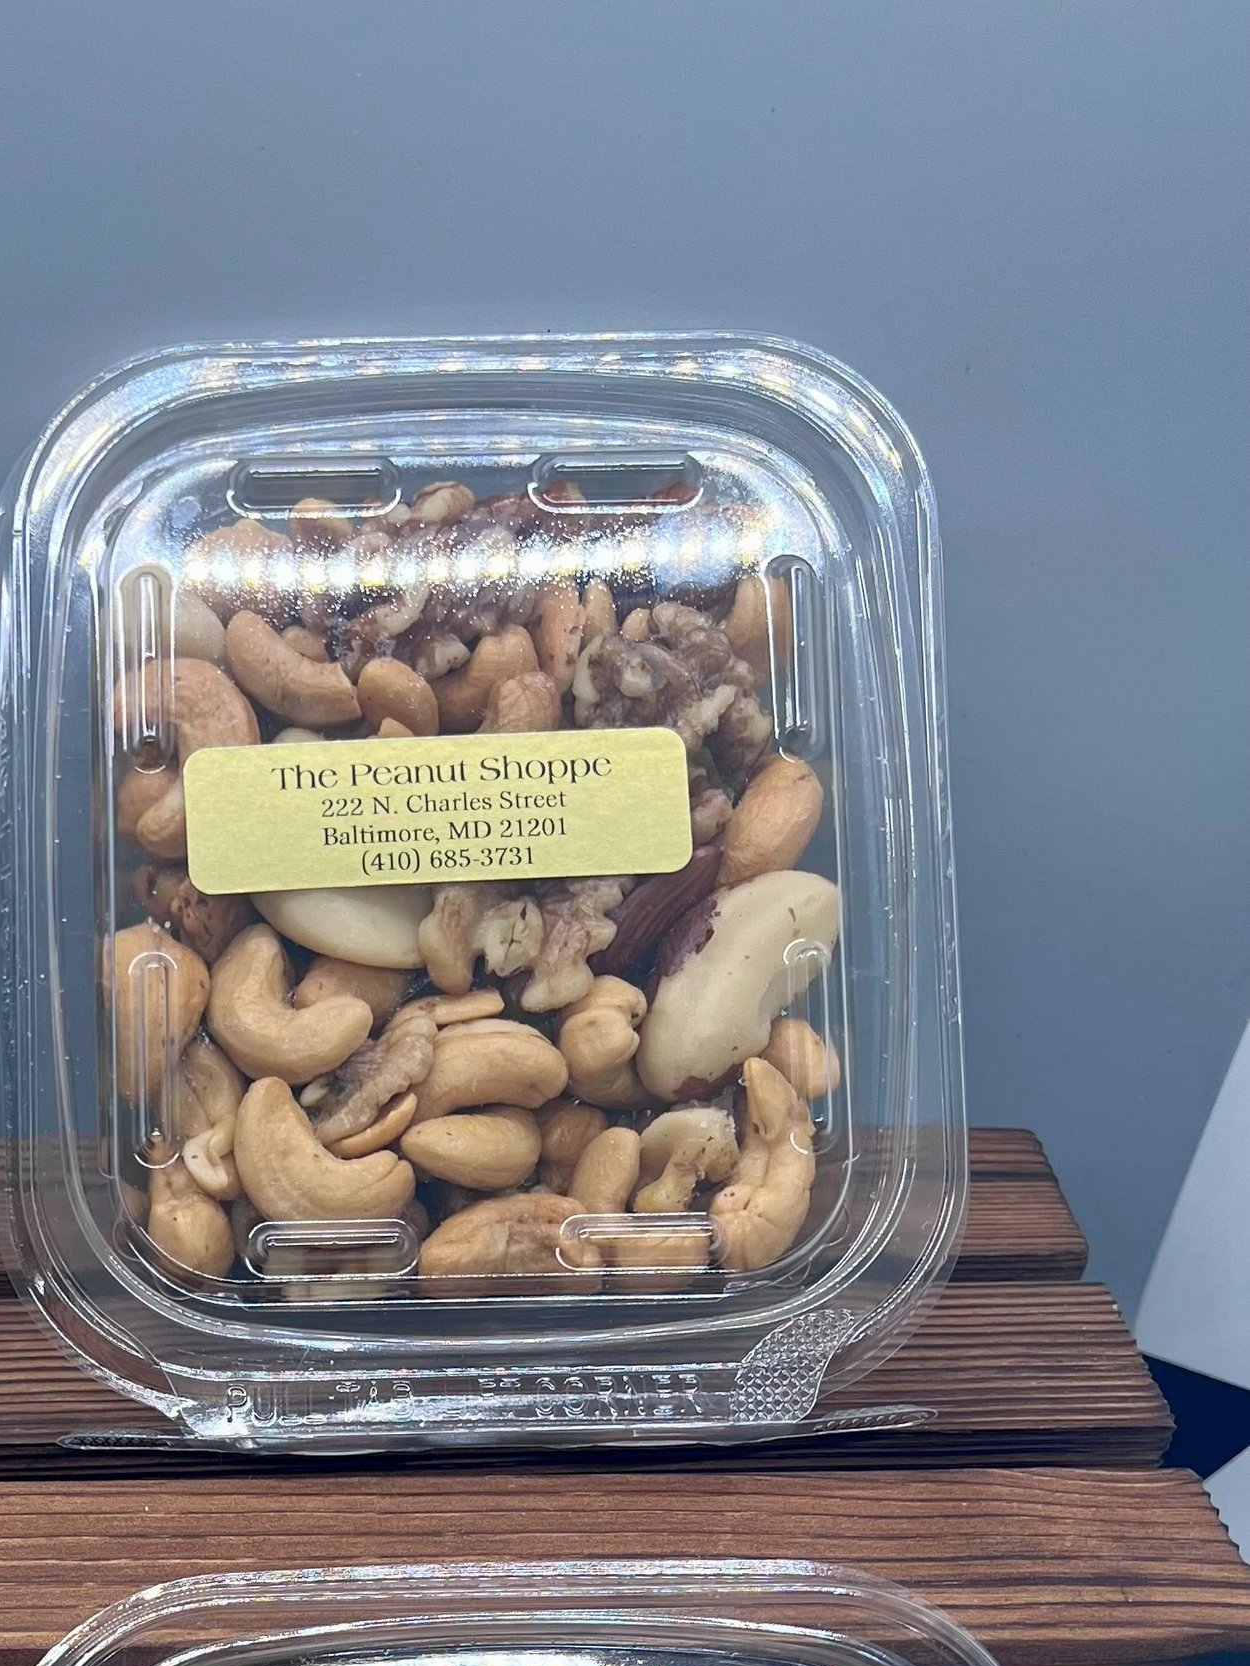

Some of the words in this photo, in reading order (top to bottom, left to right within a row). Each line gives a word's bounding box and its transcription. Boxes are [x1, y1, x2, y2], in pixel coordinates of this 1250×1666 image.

[270, 763, 339, 791] The
[349, 759, 467, 787] Peanut
[479, 754, 612, 785] Shoppe
[321, 797, 364, 818] 222
[371, 795, 399, 815] N.
[406, 791, 493, 814] Charles
[499, 790, 567, 810] Street
[321, 824, 441, 847] Baltimore,
[446, 820, 492, 841] MD
[499, 816, 567, 839] 21201
[361, 847, 421, 877] (410)
[429, 845, 534, 870] 685-3731
